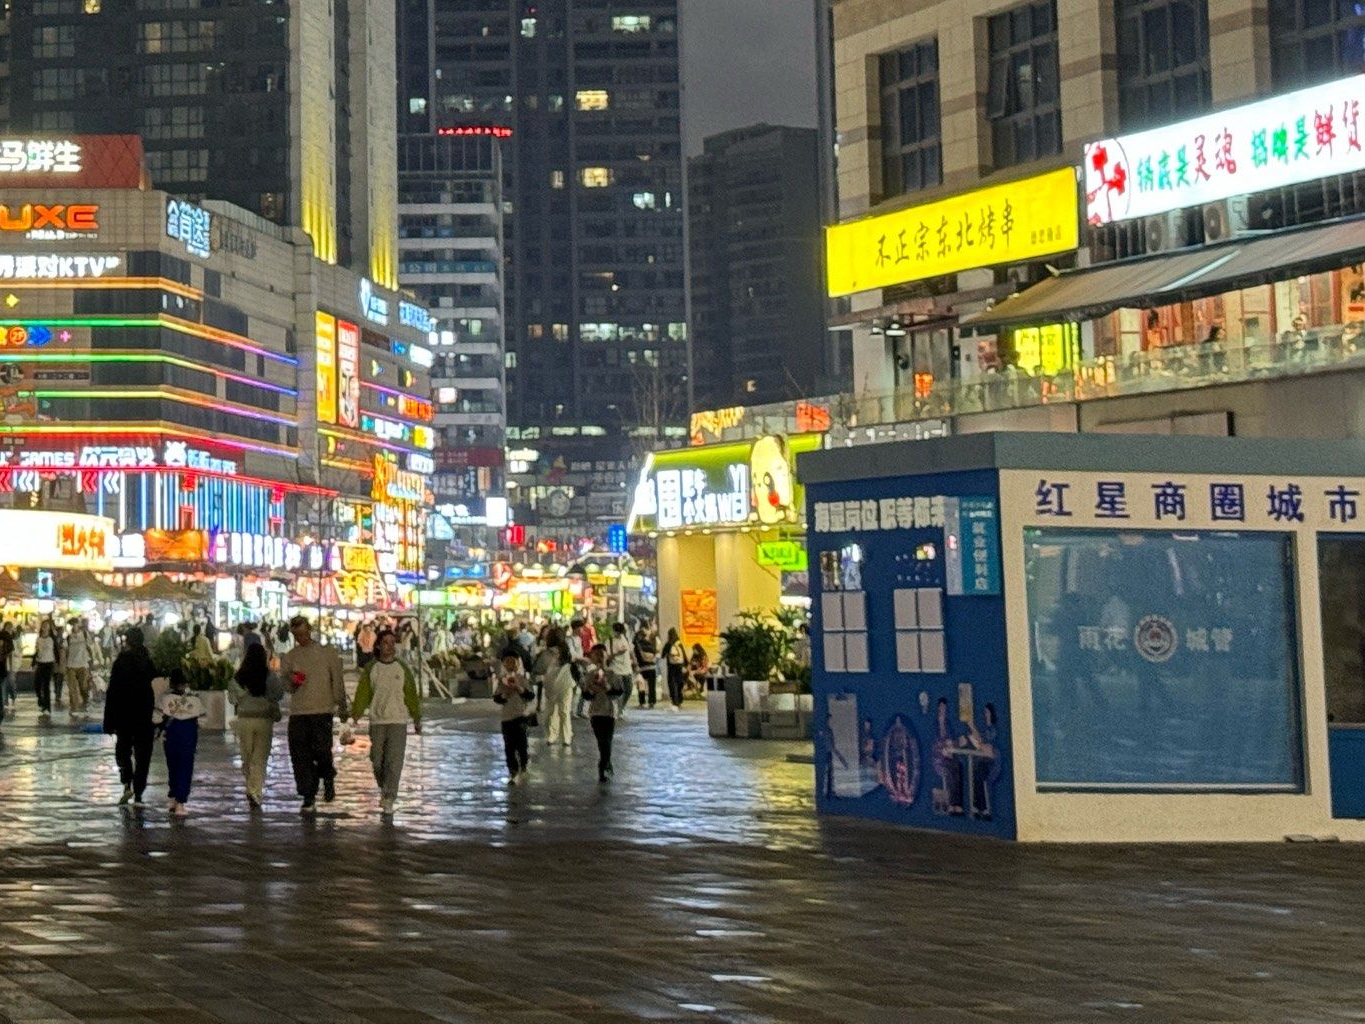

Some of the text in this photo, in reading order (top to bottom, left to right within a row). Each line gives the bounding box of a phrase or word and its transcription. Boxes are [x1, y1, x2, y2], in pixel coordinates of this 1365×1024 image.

[876, 198, 1014, 268] 不正宗东北烤串
[1035, 479, 1361, 523] 红星商圈城市
